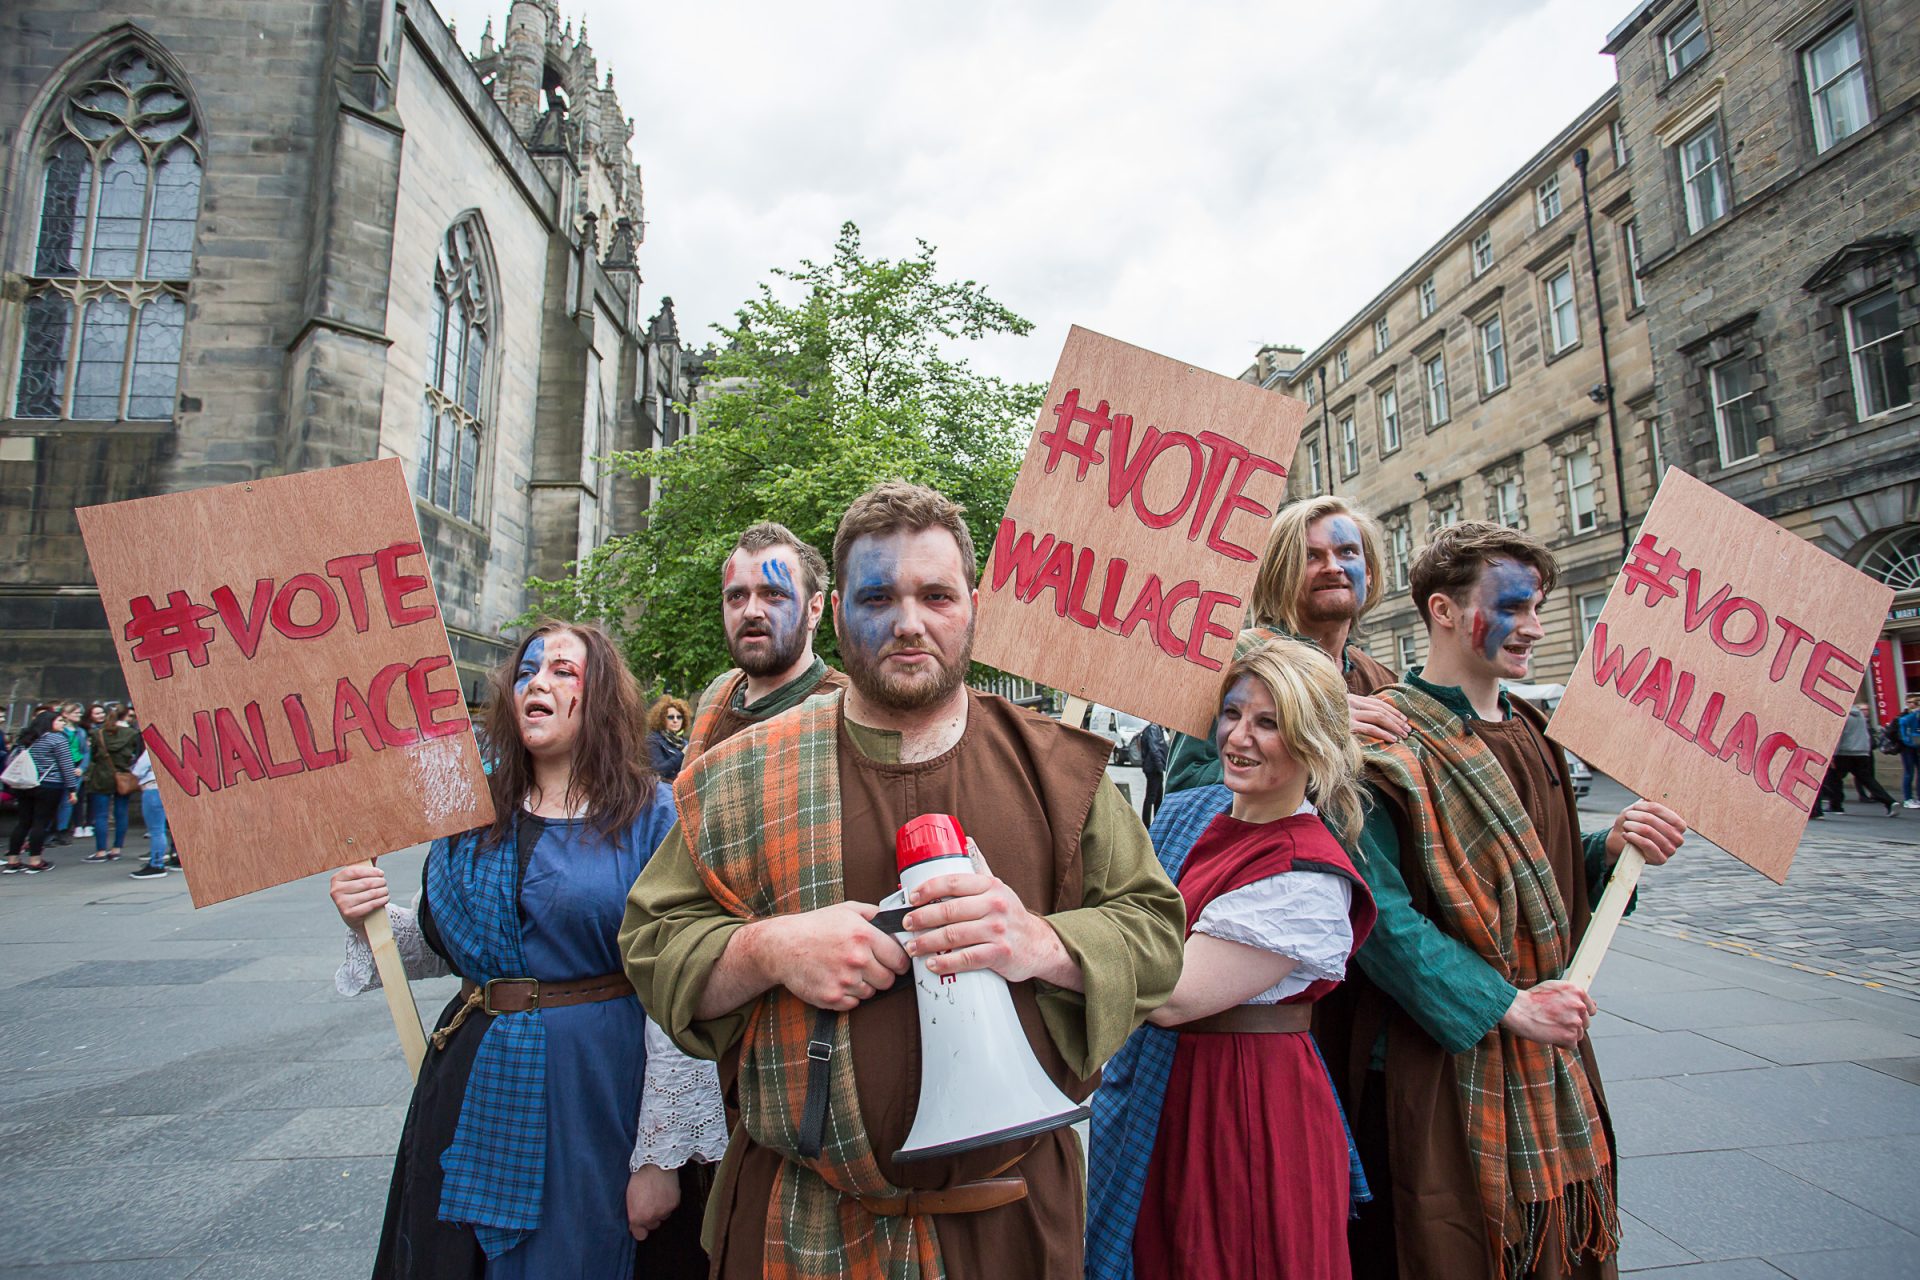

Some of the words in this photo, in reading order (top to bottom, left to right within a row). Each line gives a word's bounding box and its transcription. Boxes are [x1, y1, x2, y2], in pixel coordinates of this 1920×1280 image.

[1040, 388, 1288, 562] #VOTE
[124, 542, 436, 680] #VOTE
[992, 517, 1242, 672] WALLACE
[1622, 533, 1865, 717] #VOTE
[141, 655, 470, 797] WALLACE
[1592, 623, 1828, 813] WALLACE
[1872, 661, 1887, 716] VISITOR
